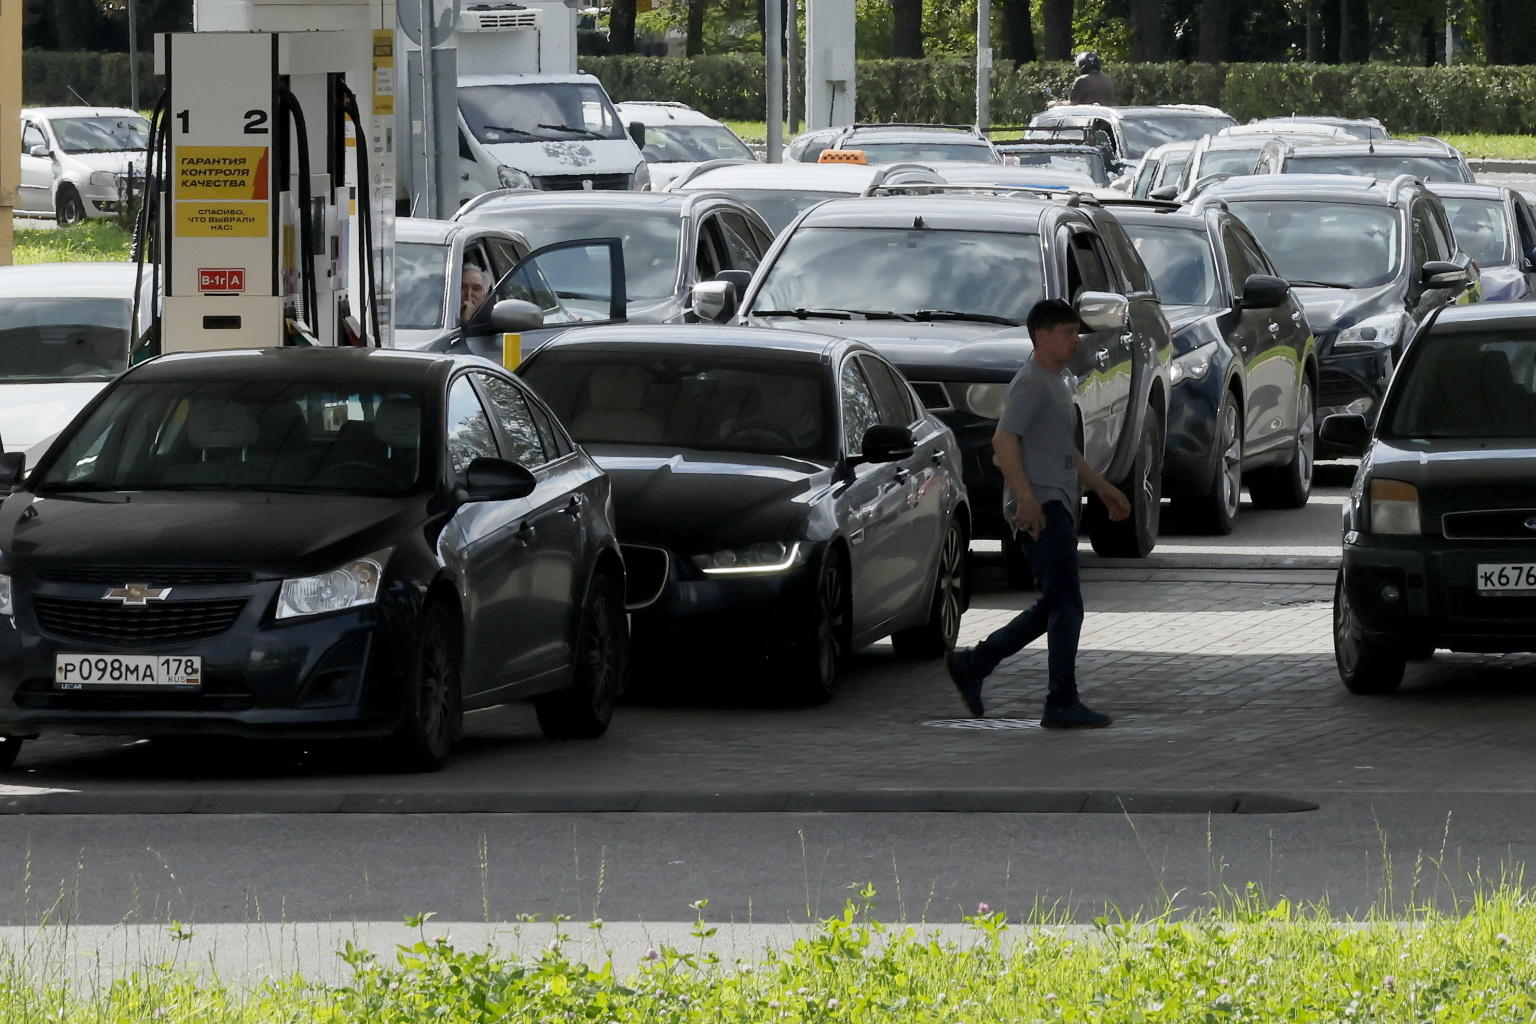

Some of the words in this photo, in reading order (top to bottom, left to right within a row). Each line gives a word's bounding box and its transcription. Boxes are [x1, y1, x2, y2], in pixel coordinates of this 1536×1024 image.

[176, 109, 190, 134] 1
[243, 109, 269, 134] 2
[181, 157, 247, 165] ГАРАНТИЯ
[181, 168, 250, 177] КОНТРОЛЯ
[181, 179, 247, 188] КАЧЕСТВА
[64, 657, 155, 682] Р098МА
[161, 658, 194, 676] 178
